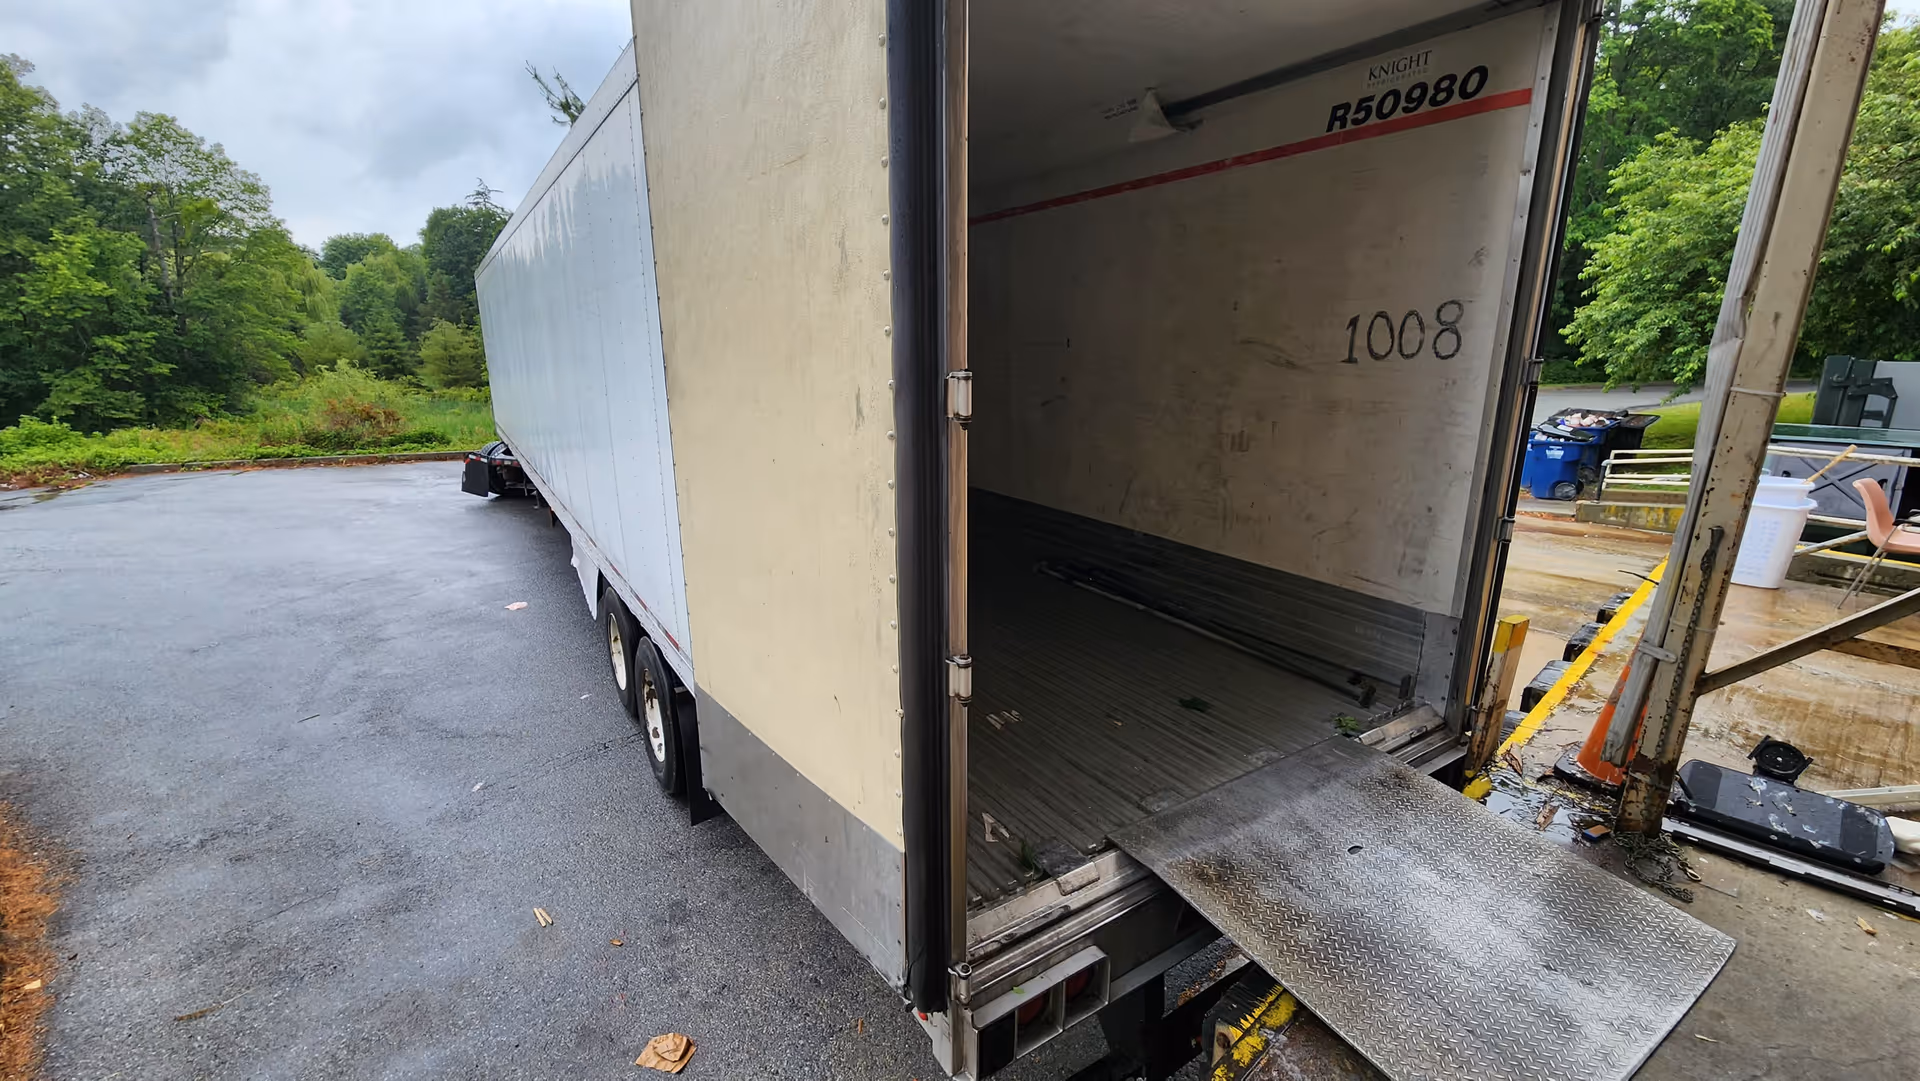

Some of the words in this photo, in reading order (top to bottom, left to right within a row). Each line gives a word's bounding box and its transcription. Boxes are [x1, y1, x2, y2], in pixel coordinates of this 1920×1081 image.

[1368, 49, 1432, 81] KNIGHT
[1325, 64, 1489, 133] R50980
[1340, 299, 1464, 364] 1008
